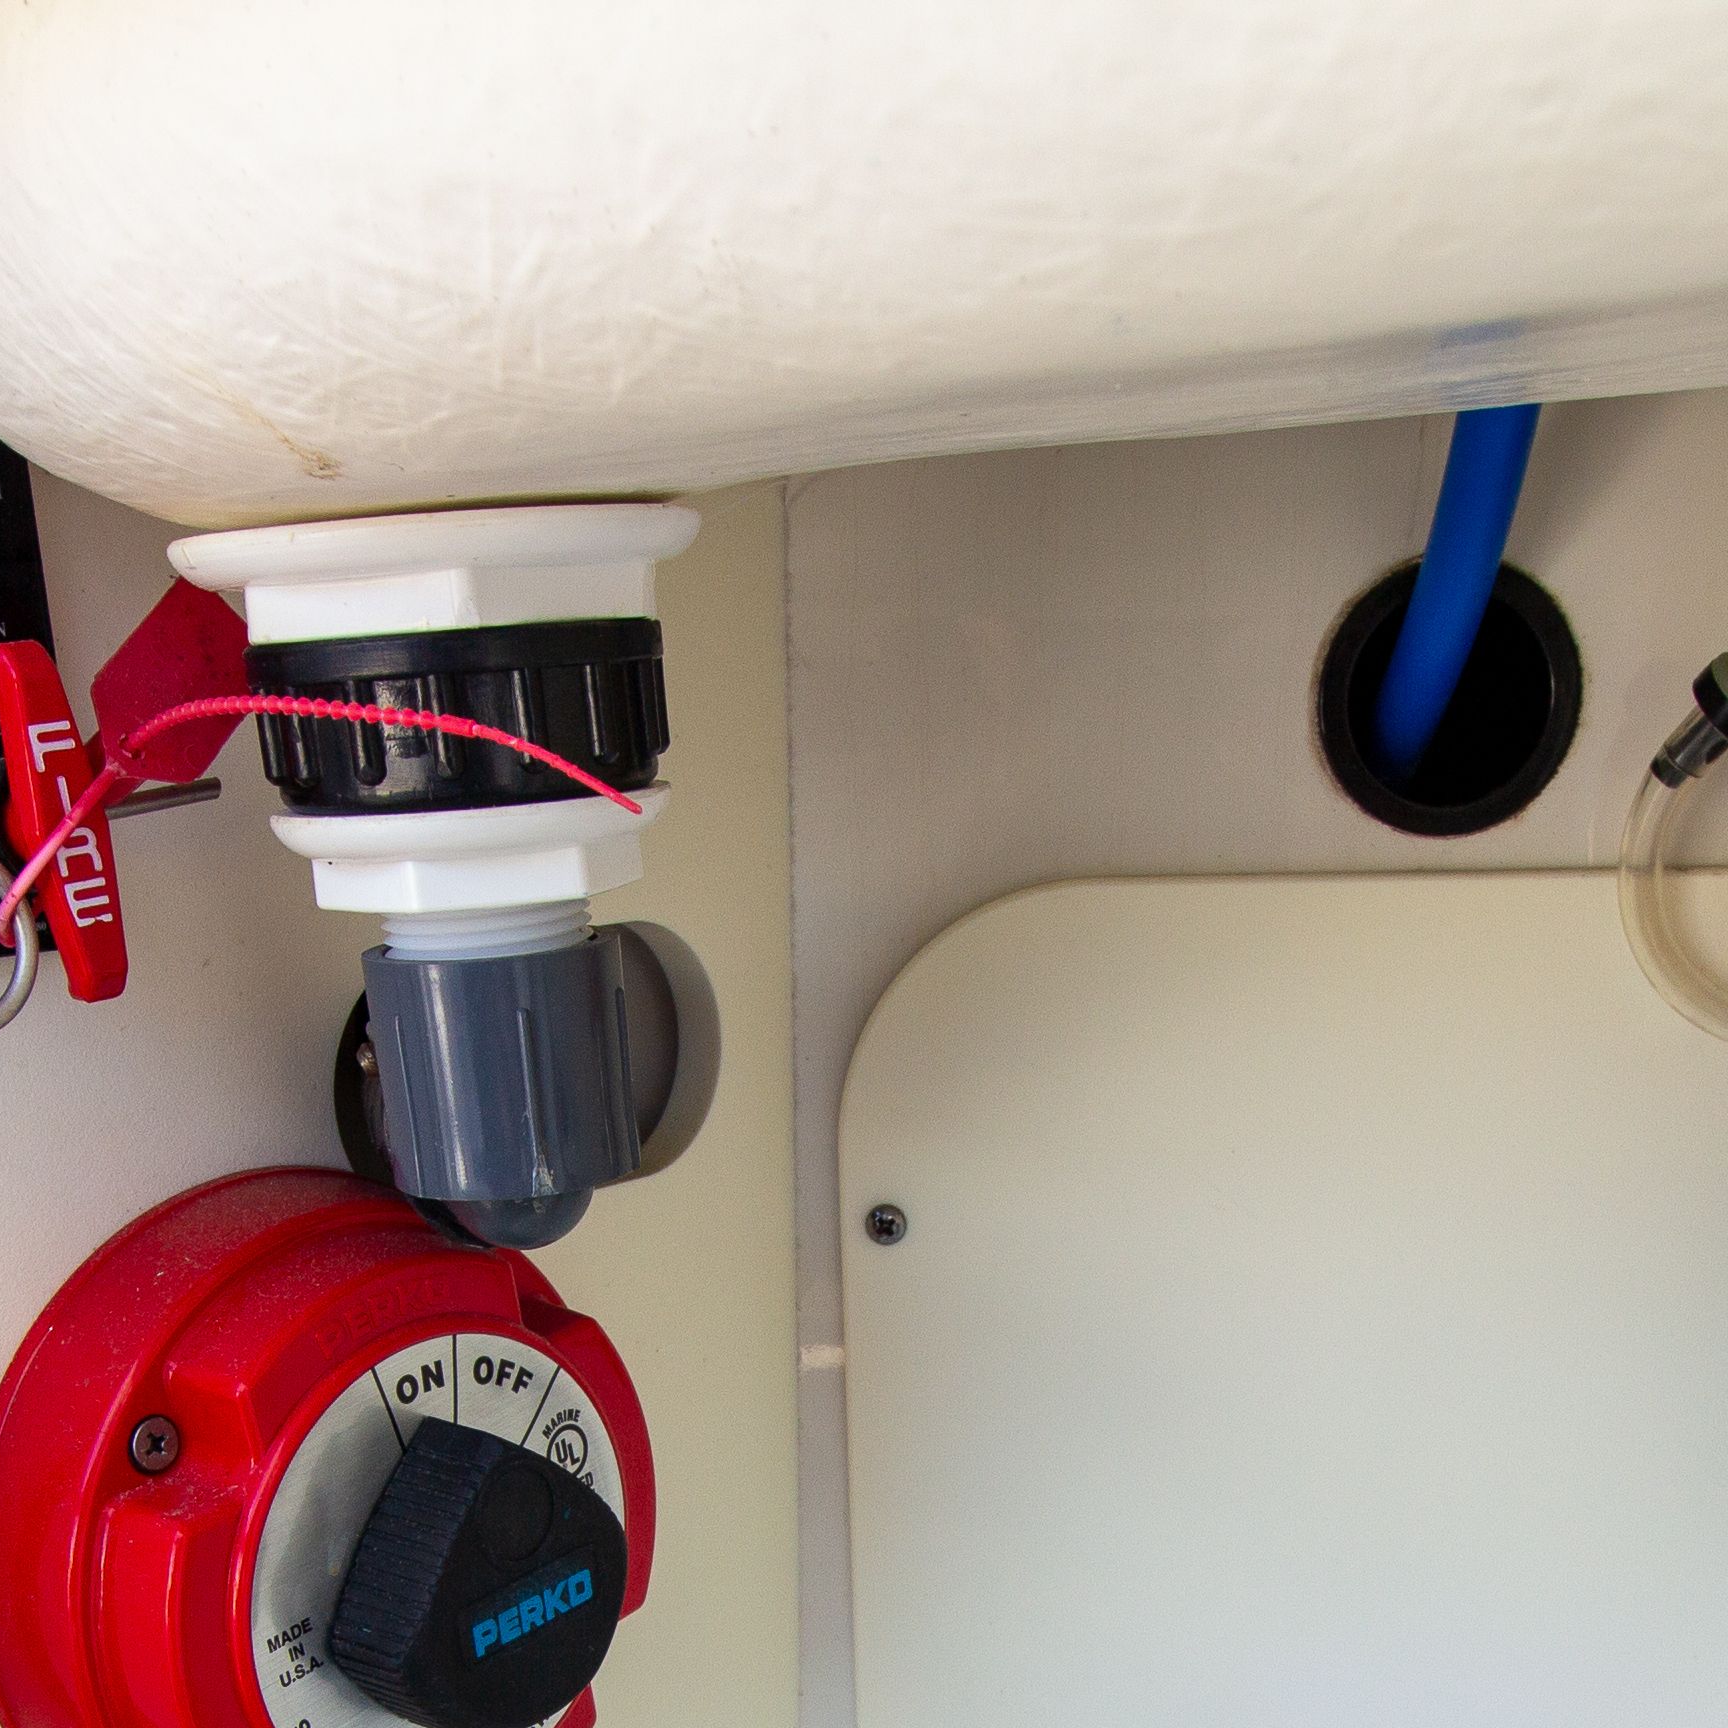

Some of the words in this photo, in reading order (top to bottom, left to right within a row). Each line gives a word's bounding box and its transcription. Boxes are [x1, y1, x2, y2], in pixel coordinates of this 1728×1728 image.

[28, 720, 114, 928] FIRE
[396, 1360, 445, 1404] ON
[473, 1355, 533, 1395] OFF
[542, 1408, 581, 1439] MARINE
[555, 1438, 580, 1466] UL
[472, 1569, 592, 1658] PERKO
[267, 1617, 313, 1655] MADE
[288, 1643, 305, 1662] IN
[279, 1659, 324, 1689] U.S.A.
